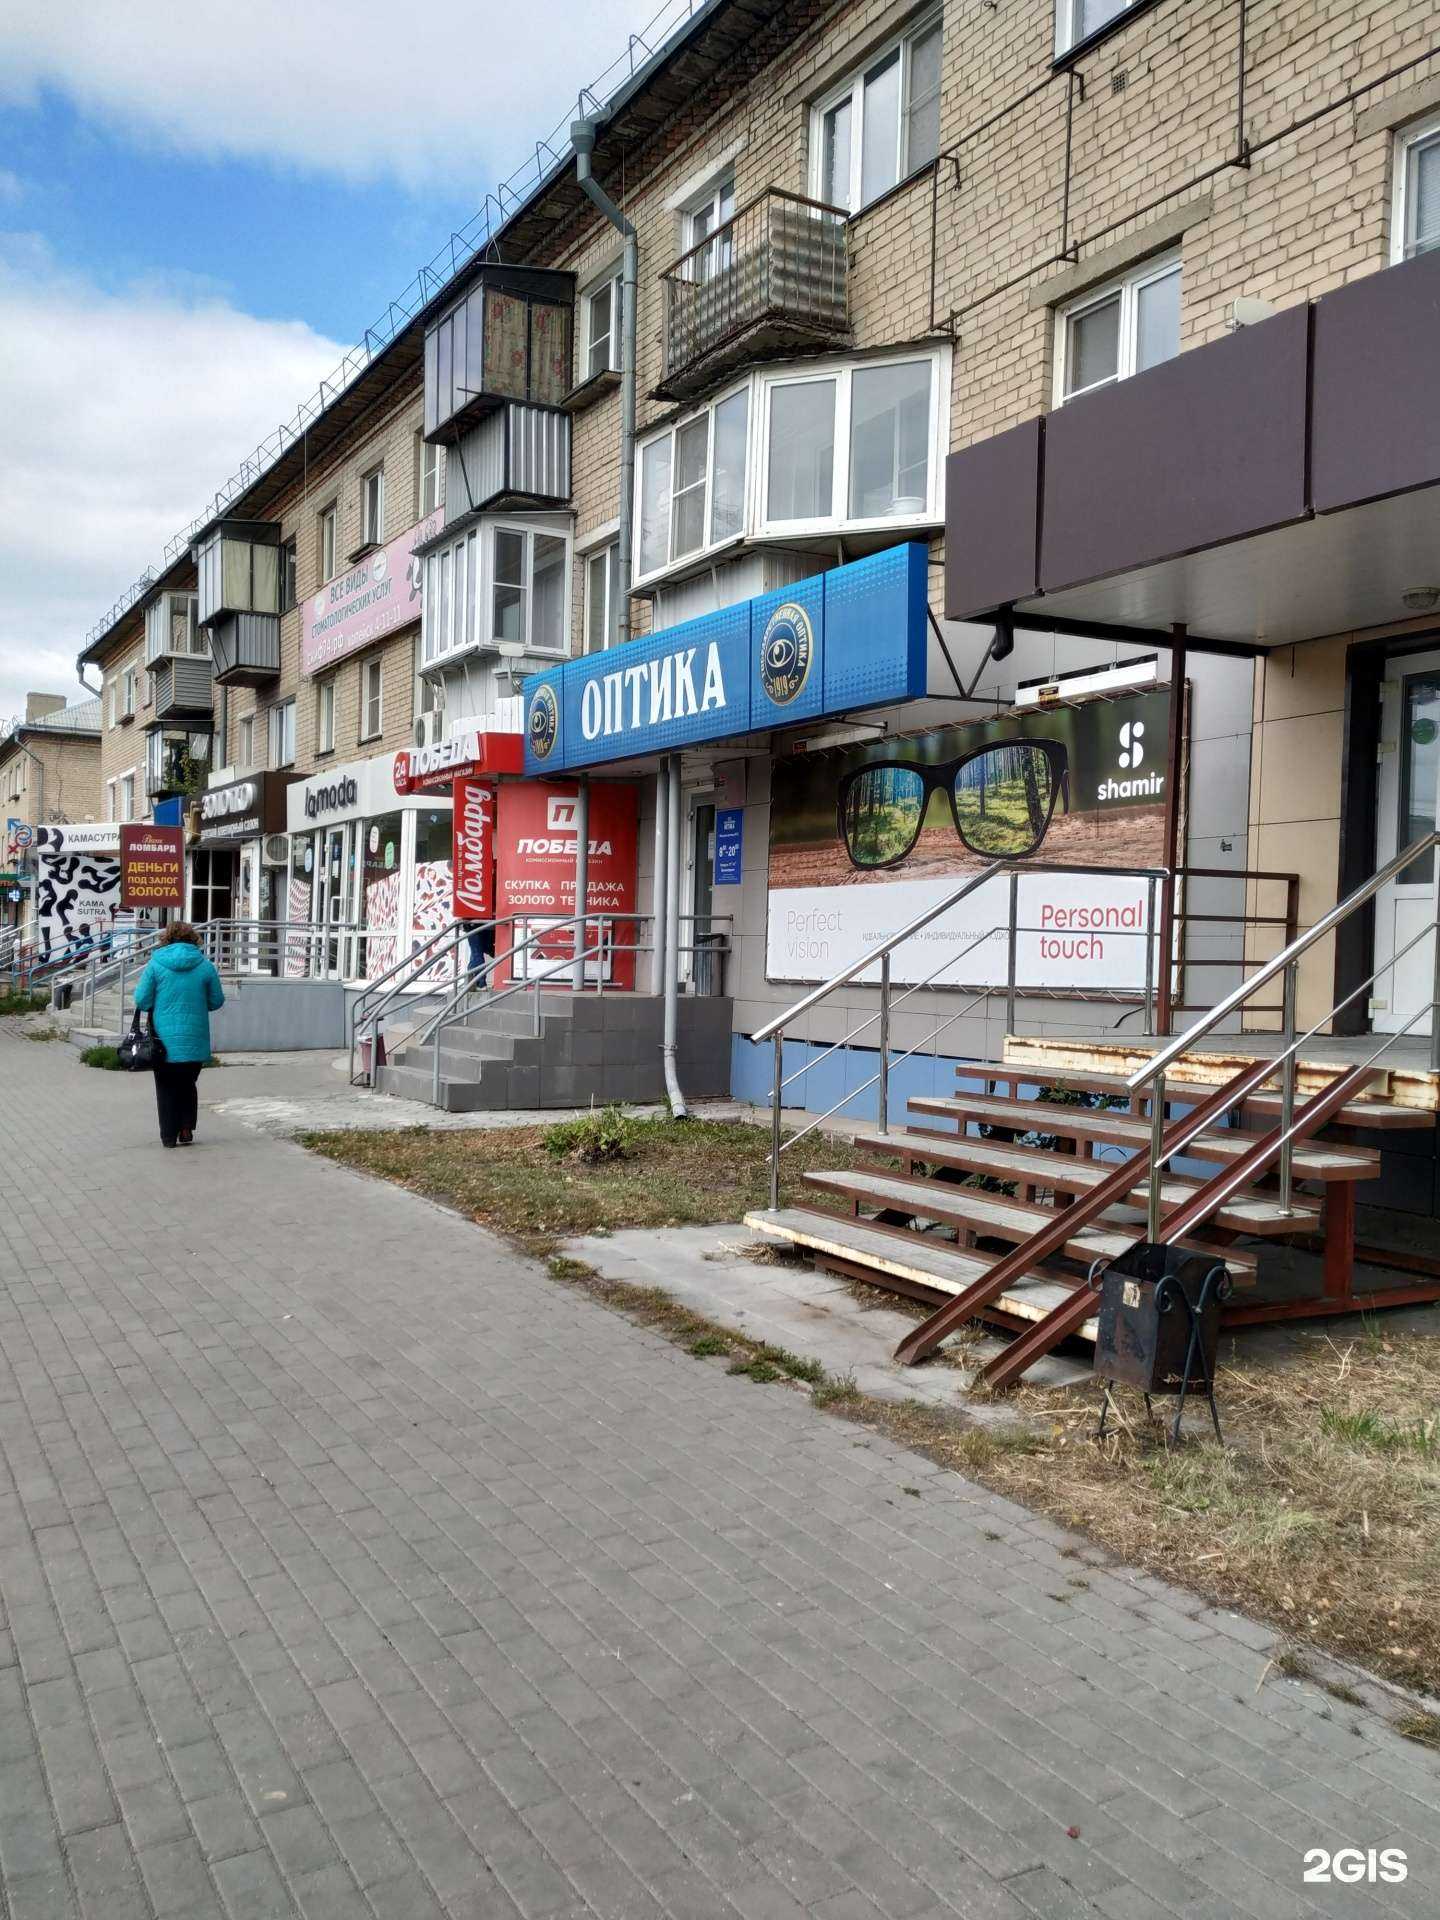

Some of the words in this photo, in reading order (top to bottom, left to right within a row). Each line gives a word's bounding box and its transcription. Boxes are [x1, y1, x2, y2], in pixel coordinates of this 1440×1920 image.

[330, 584, 344, 604] ВСЕ
[345, 564, 369, 595] ВИДЫ
[581, 641, 726, 740] ОПТИКА
[409, 731, 481, 777] ПОБЕДА
[304, 774, 358, 818] lamoda
[1097, 771, 1165, 801] shamir
[129, 843, 177, 853] ЛОМБАРД
[456, 785, 491, 912] Ломбард
[128, 861, 179, 873] ДЕНЬГИ
[128, 876, 148, 885] ПОД
[149, 876, 178, 884] ЗАЛОГ
[128, 886, 179, 897] ЗОЛОТА
[504, 880, 550, 890] СКУПКА
[560, 880, 624, 893] ПРДАЖА
[77, 908, 106, 916] SUTRA
[508, 895, 555, 906] ЗОЛОТО
[559, 895, 620, 907] ТЕНИКА
[787, 908, 844, 931] Perfect
[1041, 899, 1143, 928] Personal
[787, 936, 829, 960] vision
[1040, 931, 1104, 960] touch
